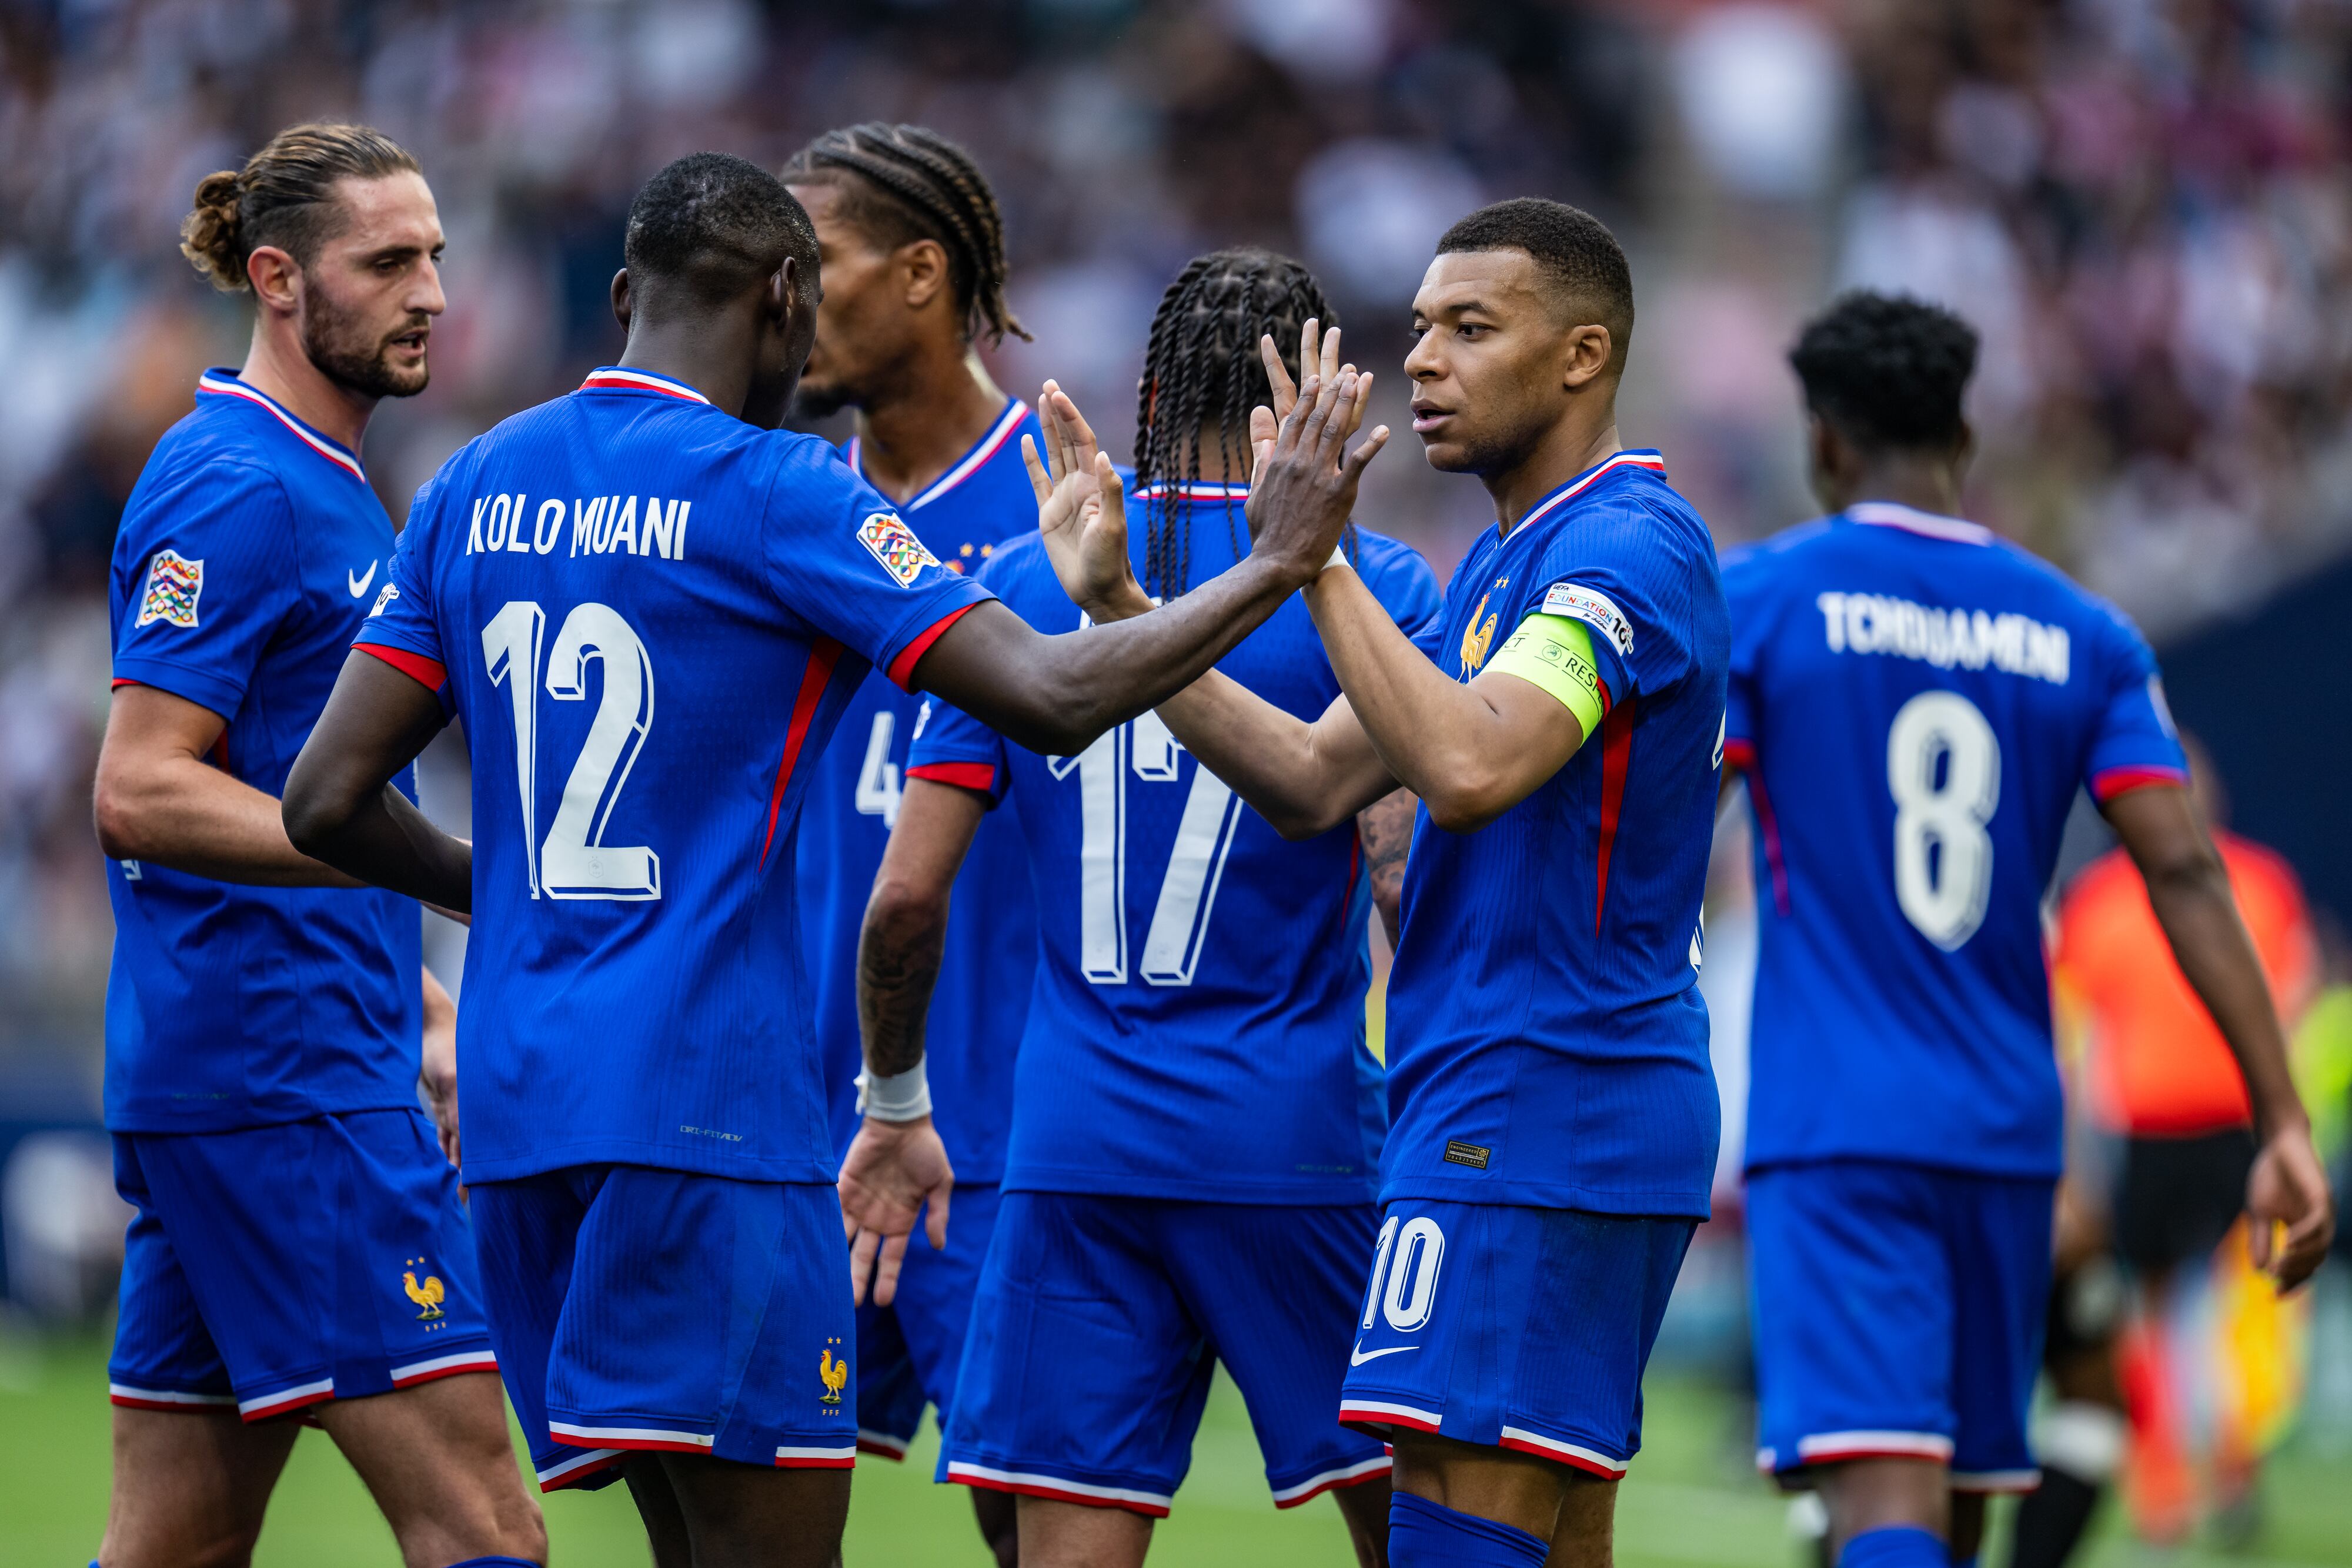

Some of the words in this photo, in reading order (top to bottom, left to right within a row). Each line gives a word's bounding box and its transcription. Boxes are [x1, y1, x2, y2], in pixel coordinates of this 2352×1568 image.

[466, 493, 566, 556] KOLO
[570, 495, 691, 560] MUANI
[1613, 617, 1628, 645] 10
[482, 601, 661, 900] 12
[855, 711, 903, 830] 4
[1047, 708, 1244, 987] 17
[1886, 690, 2002, 953] 8
[1450, 1145, 1477, 1154] ENGINEERED
[1363, 1216, 1445, 1332] 10
